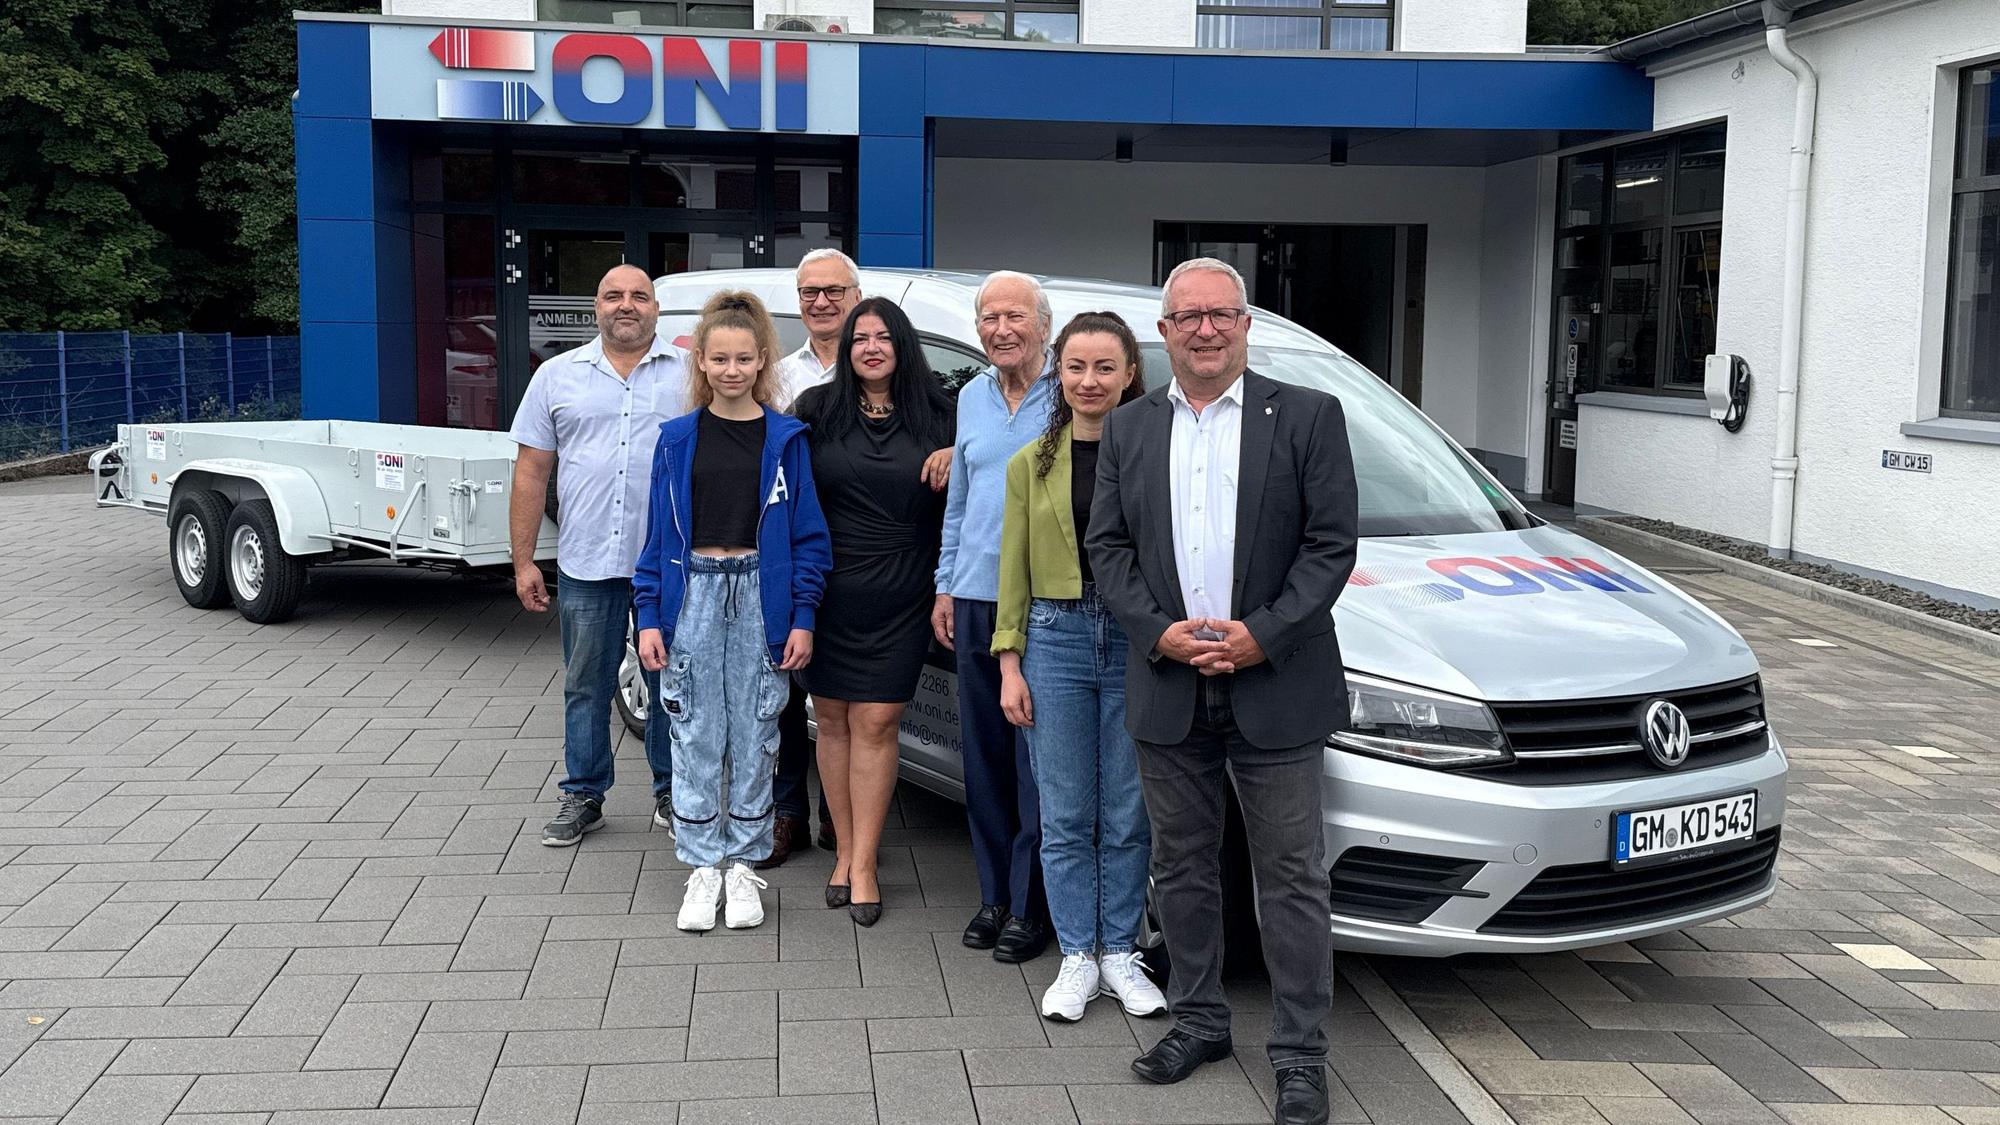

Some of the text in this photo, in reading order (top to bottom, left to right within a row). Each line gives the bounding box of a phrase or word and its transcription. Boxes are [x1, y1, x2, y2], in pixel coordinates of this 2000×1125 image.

[552, 33, 808, 131] ONI
[152, 431, 165, 442] ONI
[384, 454, 403, 468] ONI
[769, 465, 789, 504] A
[1425, 556, 1656, 596] ONI
[921, 672, 950, 697] 2266
[906, 699, 960, 726] ww.oni.de
[1632, 813, 1665, 853] GM
